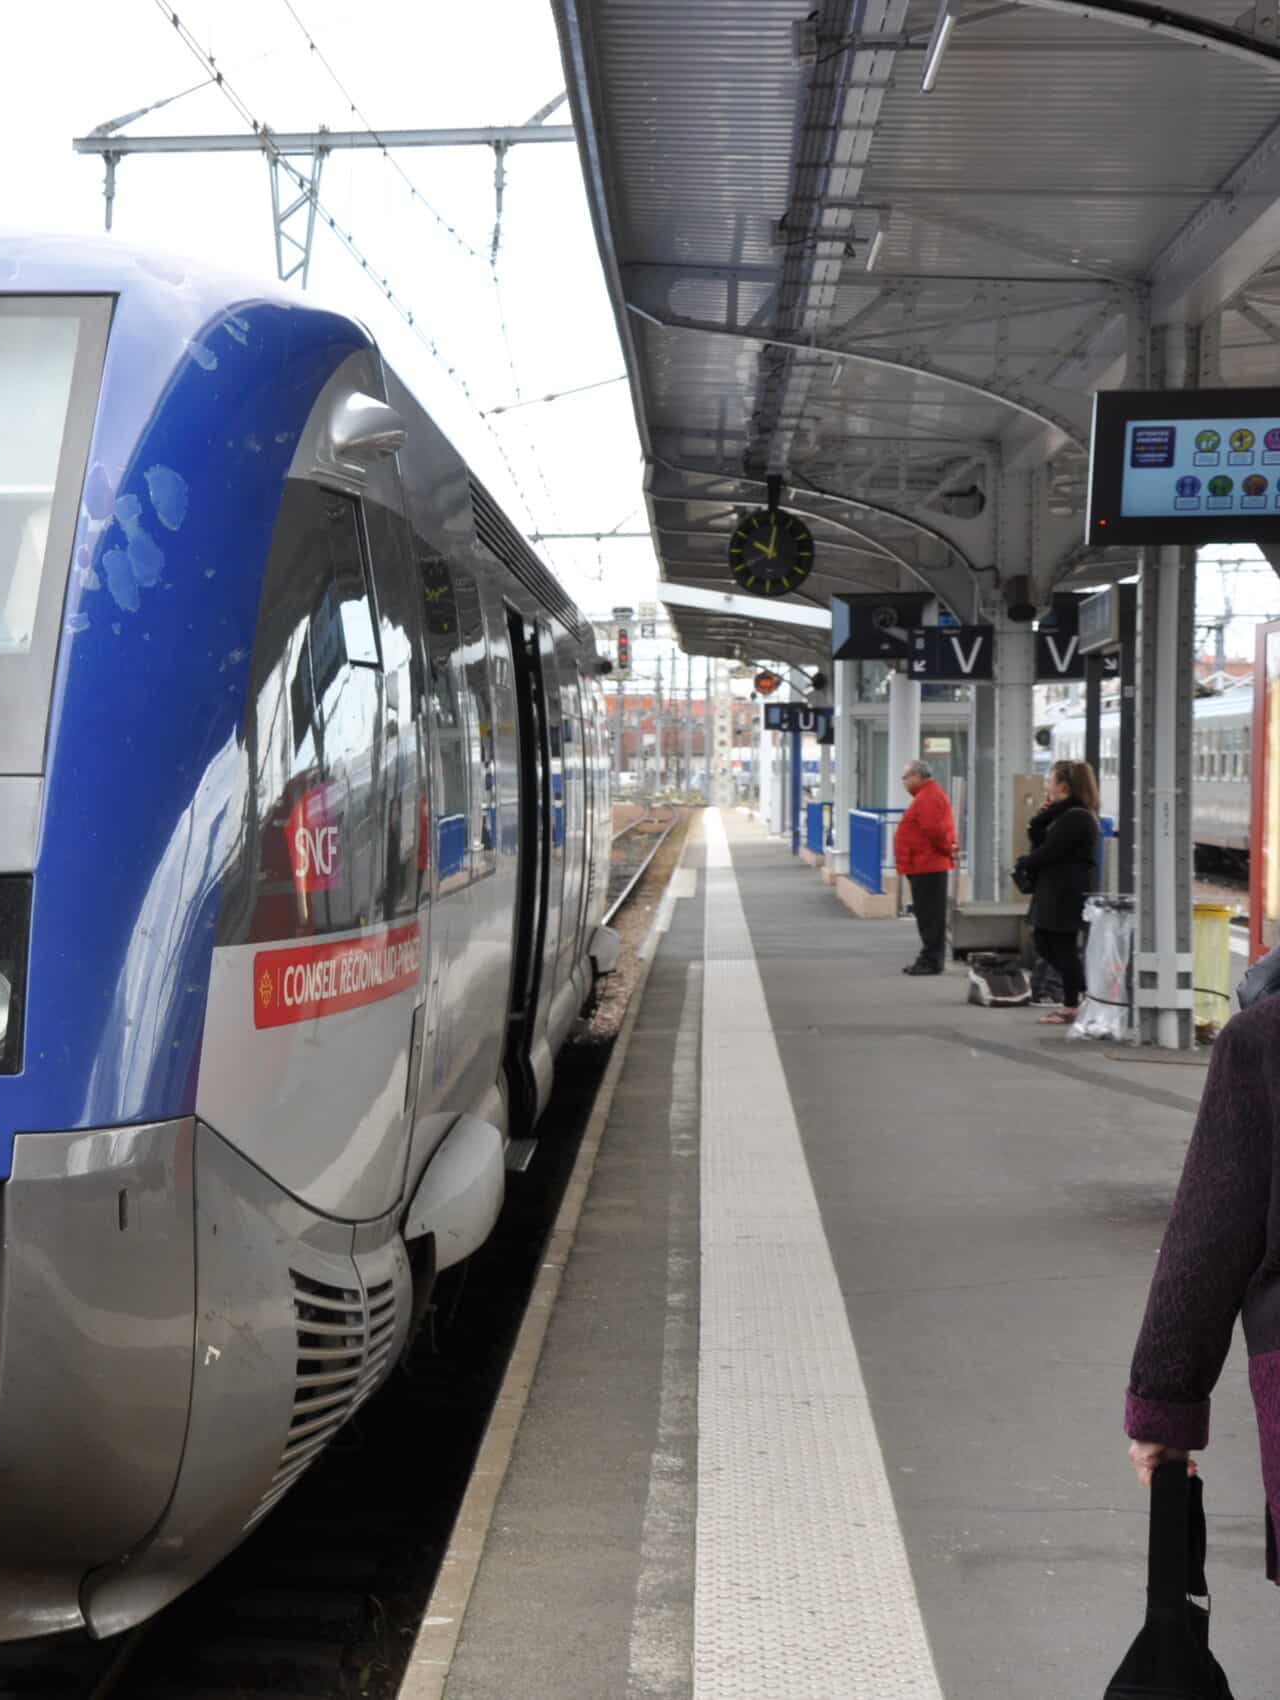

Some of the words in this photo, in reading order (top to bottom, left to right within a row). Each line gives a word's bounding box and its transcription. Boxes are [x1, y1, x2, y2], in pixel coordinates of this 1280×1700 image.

[950, 636, 984, 674] V
[1046, 635, 1079, 672] V
[799, 711, 814, 730] U
[295, 826, 338, 877] SNCF
[284, 958, 337, 1006] CONSEIL
